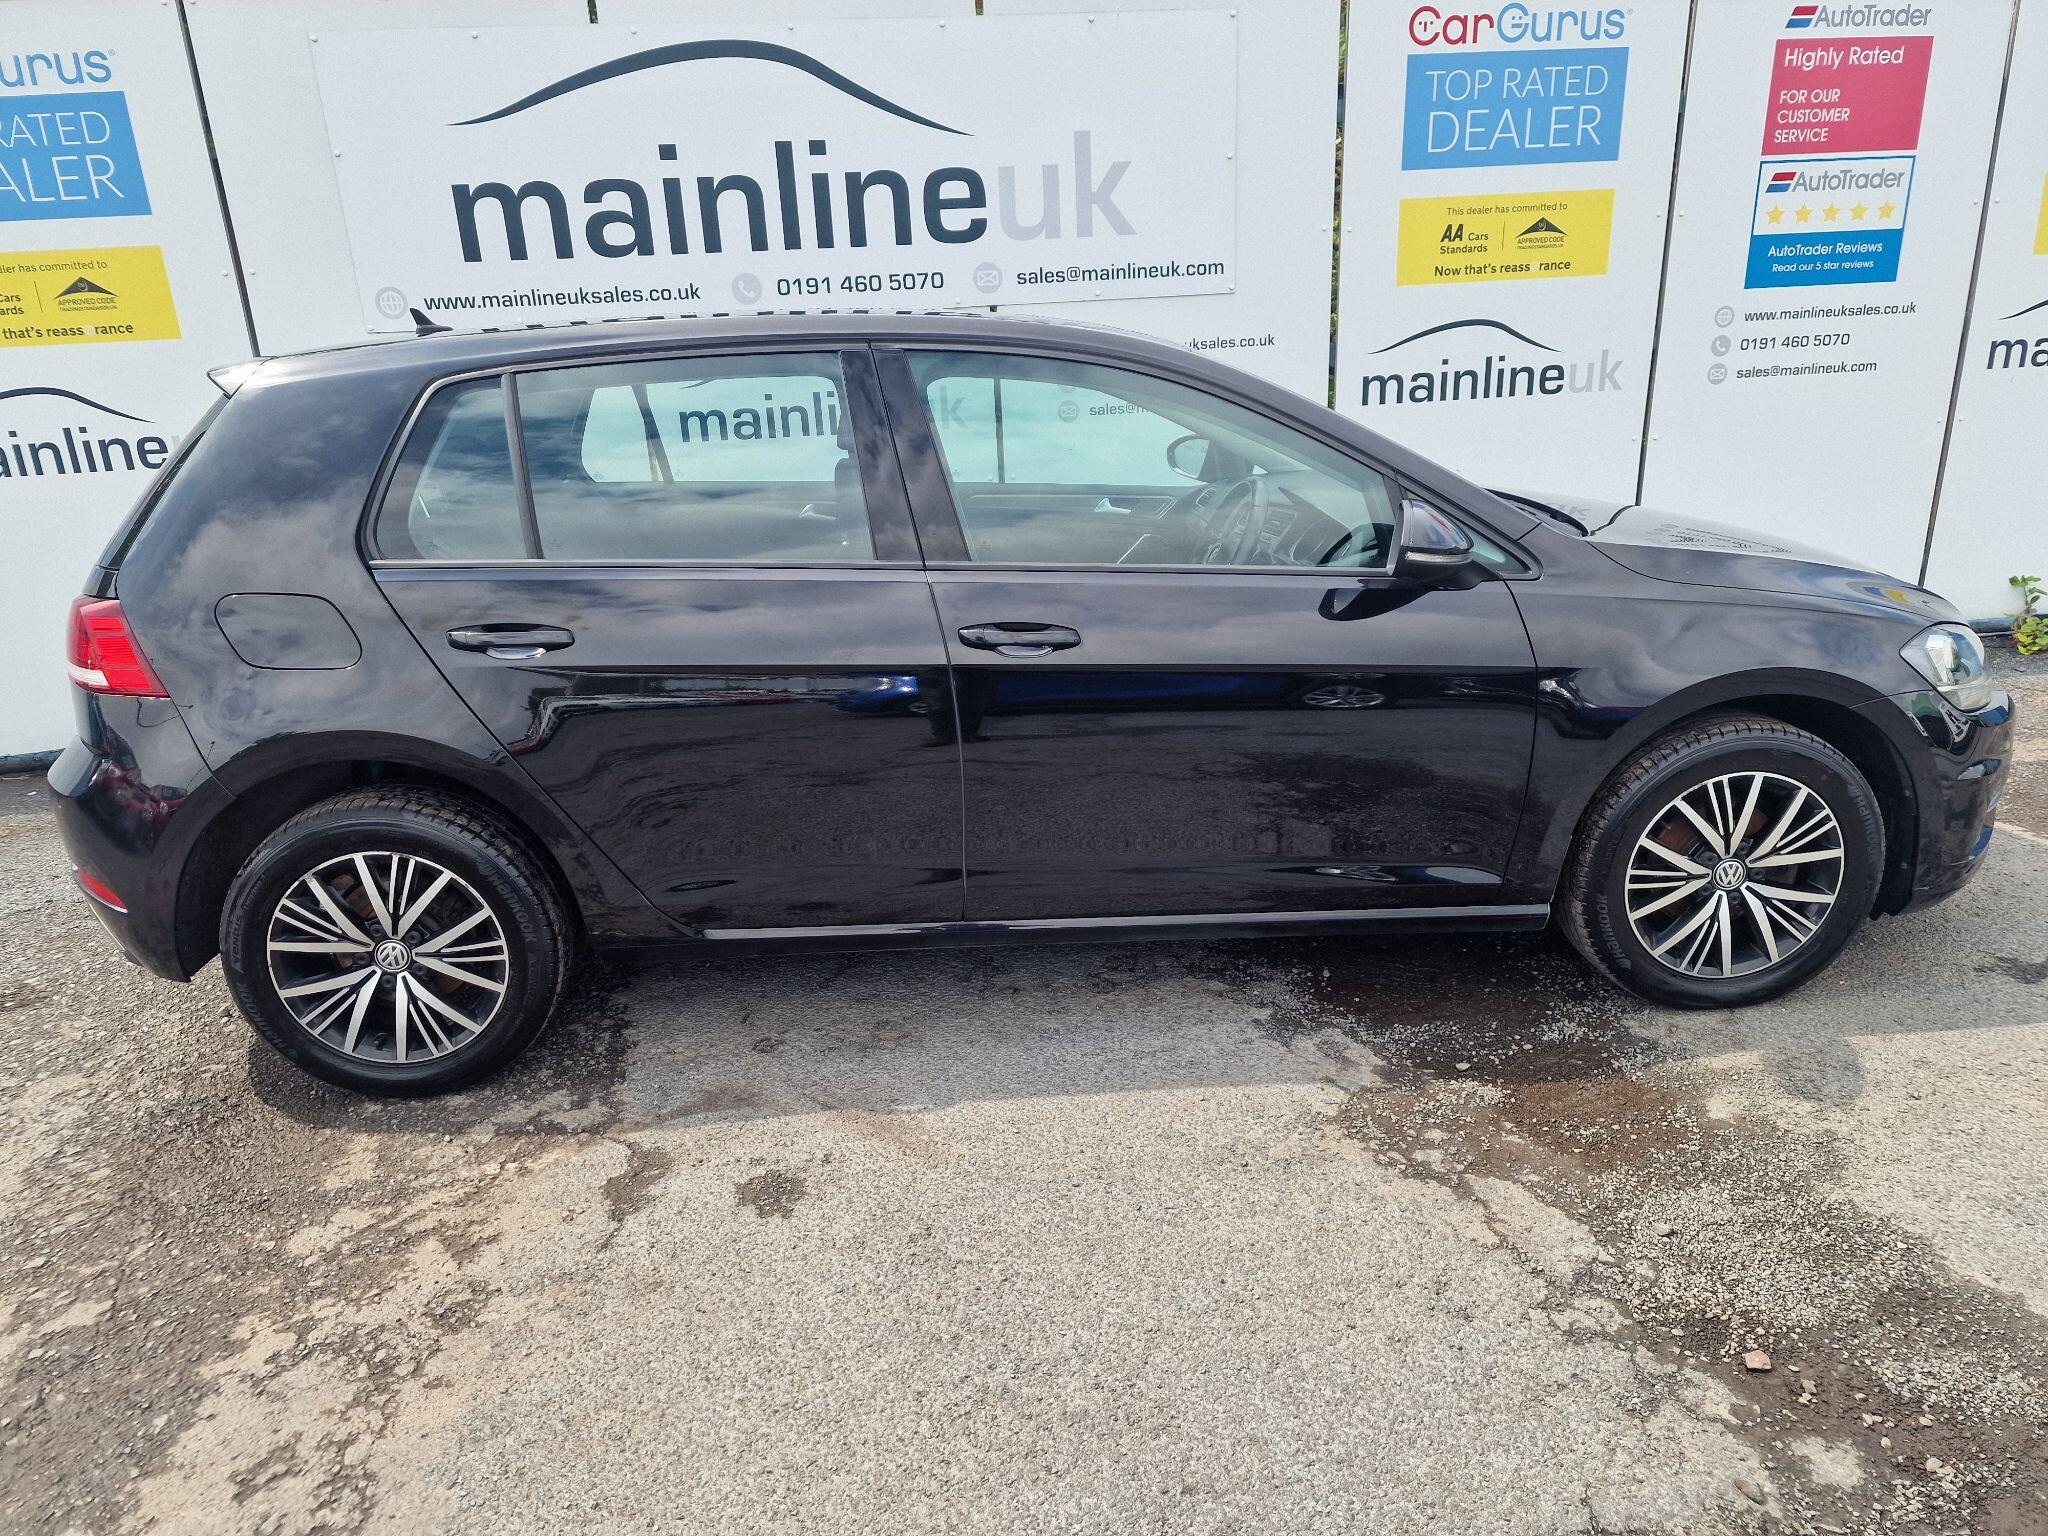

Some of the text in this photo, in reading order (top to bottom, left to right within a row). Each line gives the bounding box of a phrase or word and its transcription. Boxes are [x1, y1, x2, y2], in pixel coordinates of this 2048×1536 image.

[1408, 2, 1626, 47] CarGurus
[1812, 3, 1932, 28] AutoTrader
[1784, 45, 1905, 71] Highly Rated
[1425, 65, 1609, 102] TOP RATED
[1779, 88, 1841, 104] FOR OUR
[1777, 107, 1850, 124] CUSTOMER
[1427, 104, 1602, 154] DEALER
[1774, 127, 1829, 143] SERVICE
[1791, 168, 1905, 192] AutoTrader
[451, 130, 1138, 263] mainlineuk
[1446, 202, 1568, 216] This dealer has committed to
[1440, 223, 1489, 243] AA Cars
[1517, 235, 1565, 245] APPROVED CODE
[1440, 244, 1488, 255] Standards
[1767, 242, 1883, 257] AutoTrader Reviews
[19, 263, 37, 273] has
[39, 260, 94, 272] committed
[97, 261, 108, 269] to
[1016, 259, 1225, 286] sales@mainlineuk.com
[1434, 260, 1571, 277] Now that's reassrance
[1772, 260, 1874, 273] Read our 5 star reviews
[776, 272, 945, 297] 0191 460 5070
[424, 283, 702, 310] www.mainlineuksales.co.uk
[1744, 302, 1917, 323] www.mainlineuksales.co.uk
[2, 323, 134, 340] that's reassrance
[1740, 332, 1851, 352] 0191 460 5070
[1361, 348, 1624, 407] mainlineuk
[1736, 360, 1878, 380] sales@mainlineuk.com
